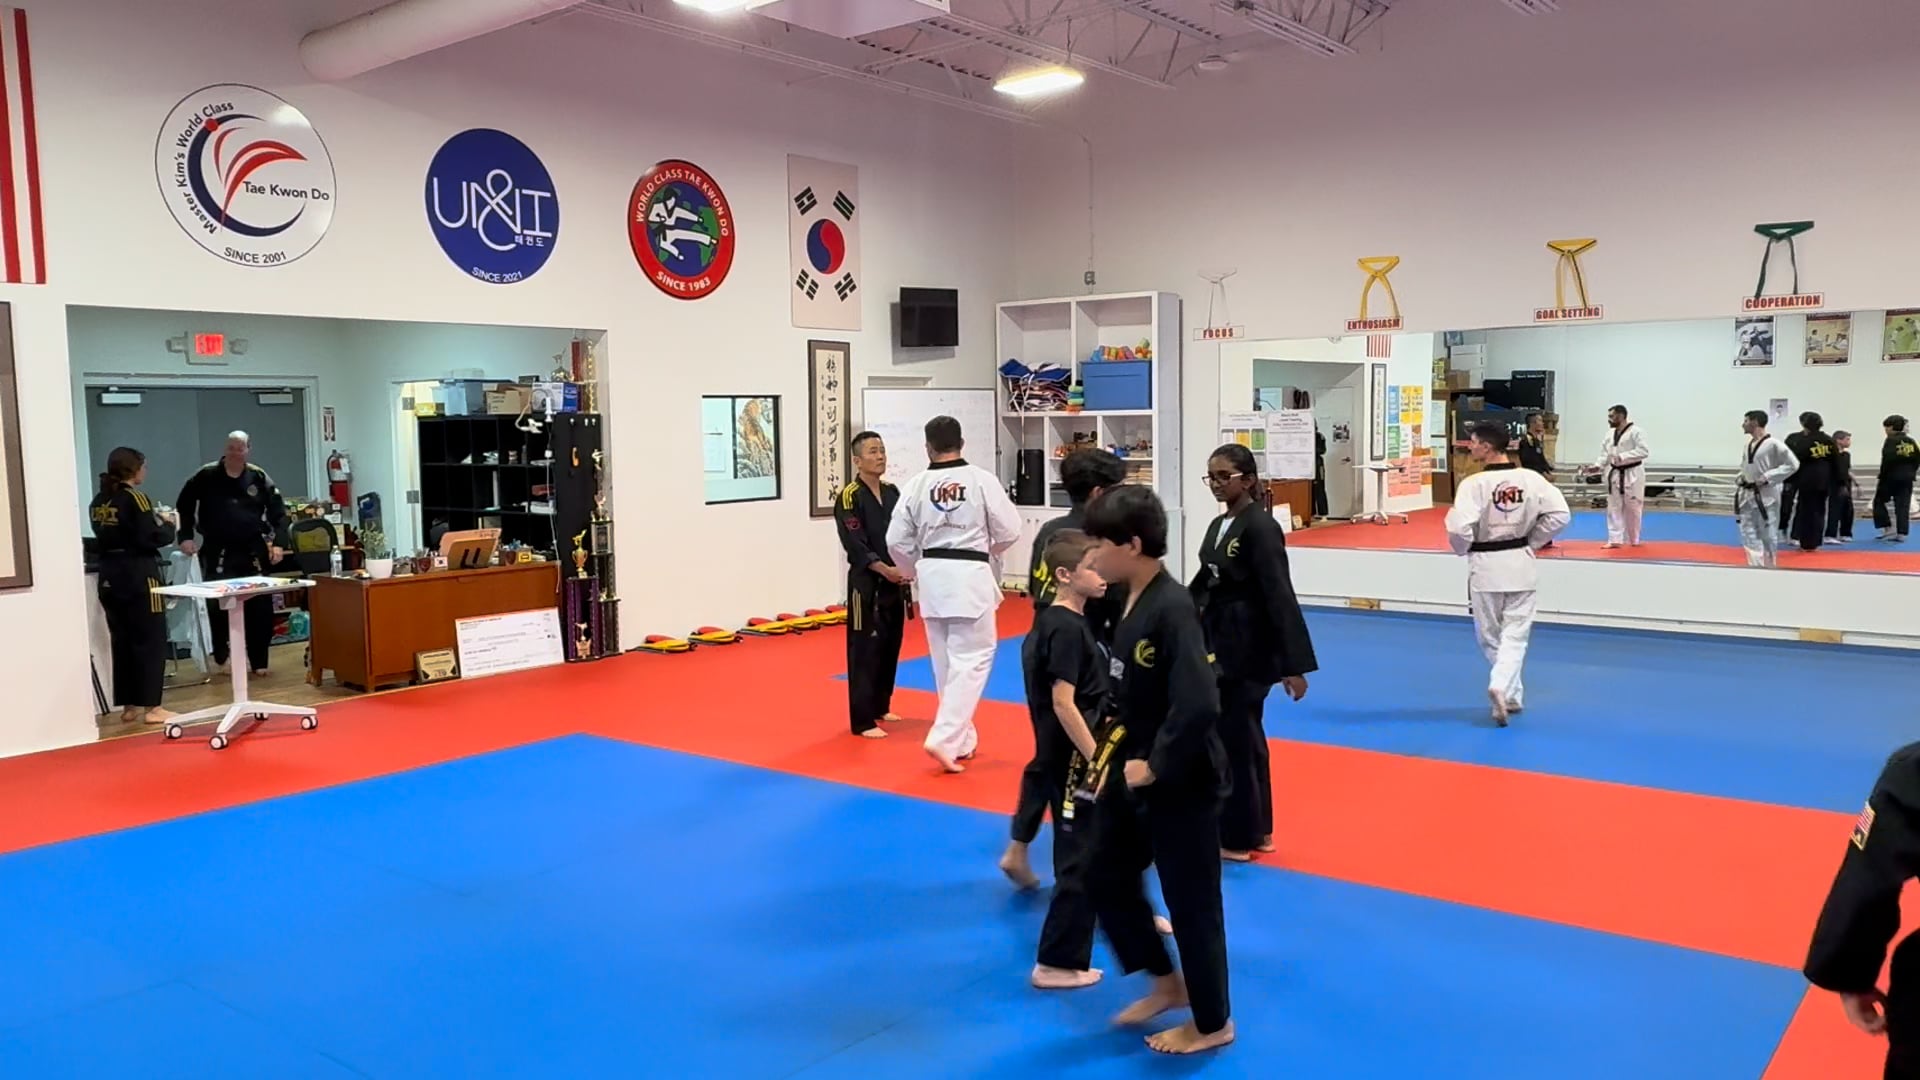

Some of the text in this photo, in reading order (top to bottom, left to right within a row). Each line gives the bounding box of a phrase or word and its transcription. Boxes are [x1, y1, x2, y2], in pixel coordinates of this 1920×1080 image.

[174, 101, 235, 235] Master Kim's World Class
[243, 180, 330, 201] Tae Kwon Do
[636, 168, 729, 237] WORLD CLASS TAE KWON DO
[223, 246, 287, 264] SINCE 2001
[471, 266, 523, 284] SINCE 2021
[655, 270, 712, 292] SINCE 1983
[1745, 294, 1821, 309] COOPERATION
[1535, 307, 1600, 320] GOAL SETTING
[1202, 327, 1234, 339] FOCUS
[1347, 318, 1400, 330] ENTHUSIASM
